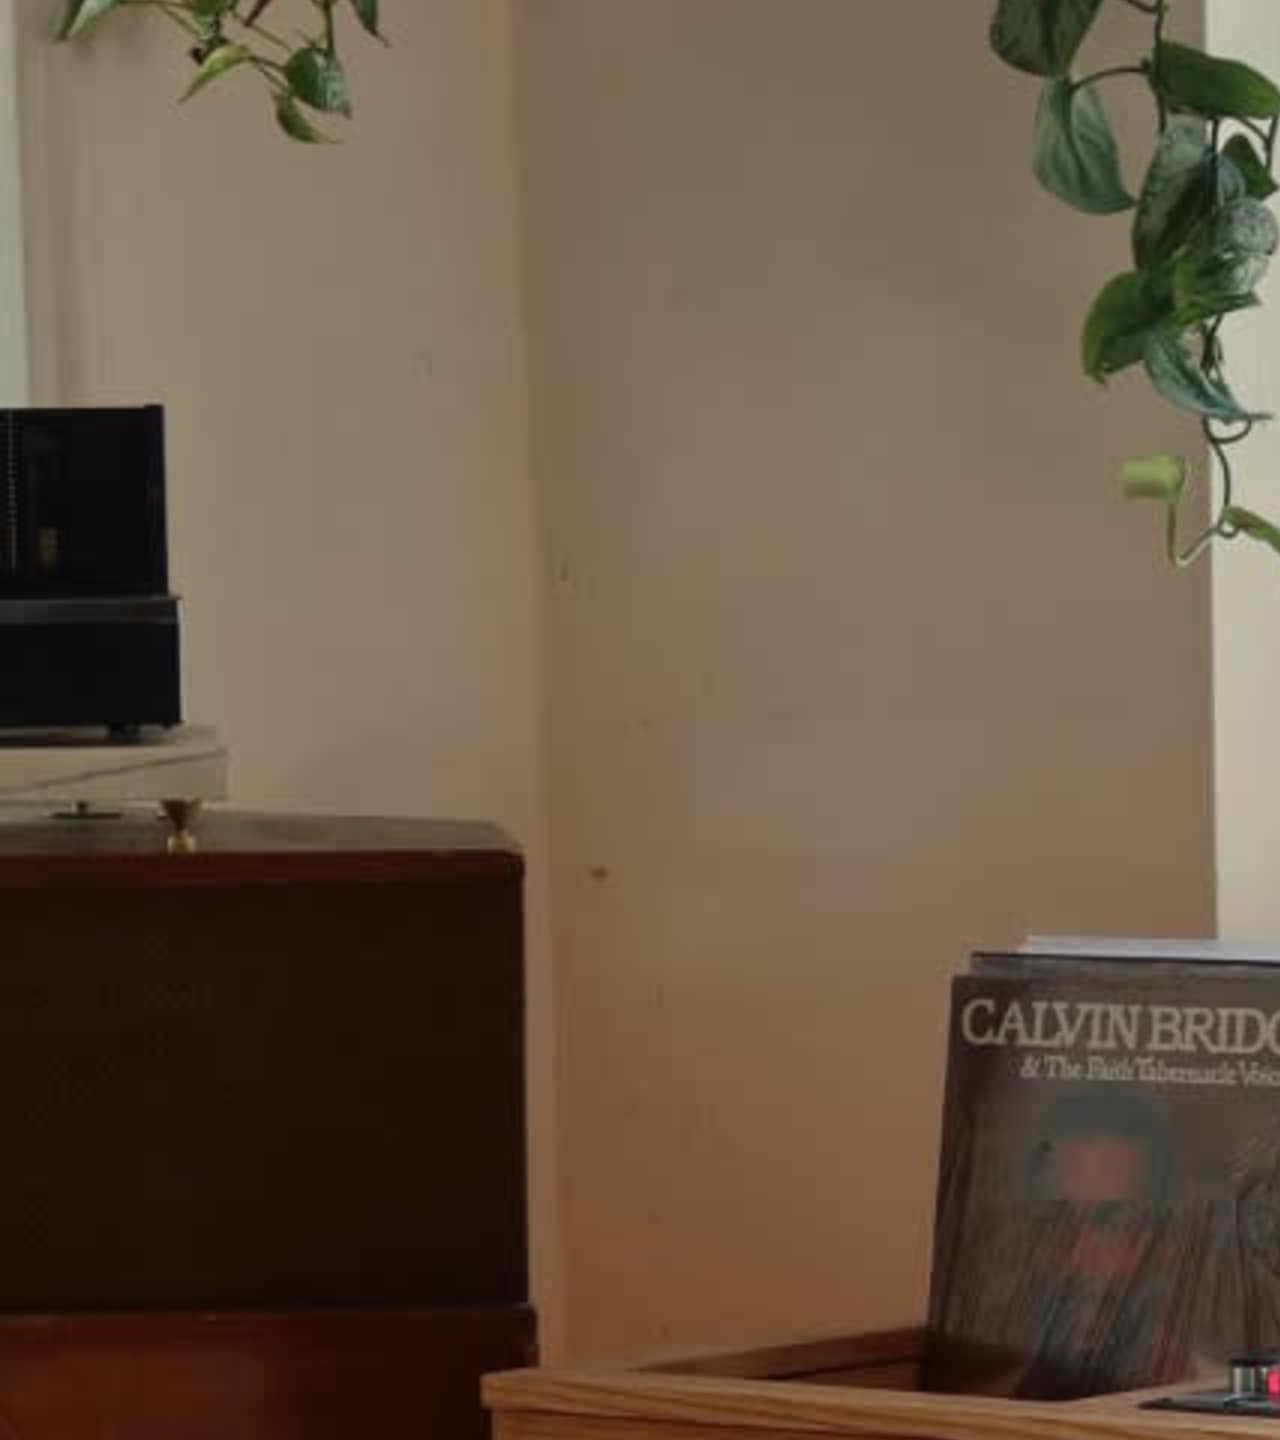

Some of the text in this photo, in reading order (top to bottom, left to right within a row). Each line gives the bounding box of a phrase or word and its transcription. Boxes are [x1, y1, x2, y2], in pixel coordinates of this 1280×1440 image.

[960, 998, 1140, 1049] CALVIN
[1020, 1057, 1040, 1081] &
[1045, 1055, 1088, 1082] The
